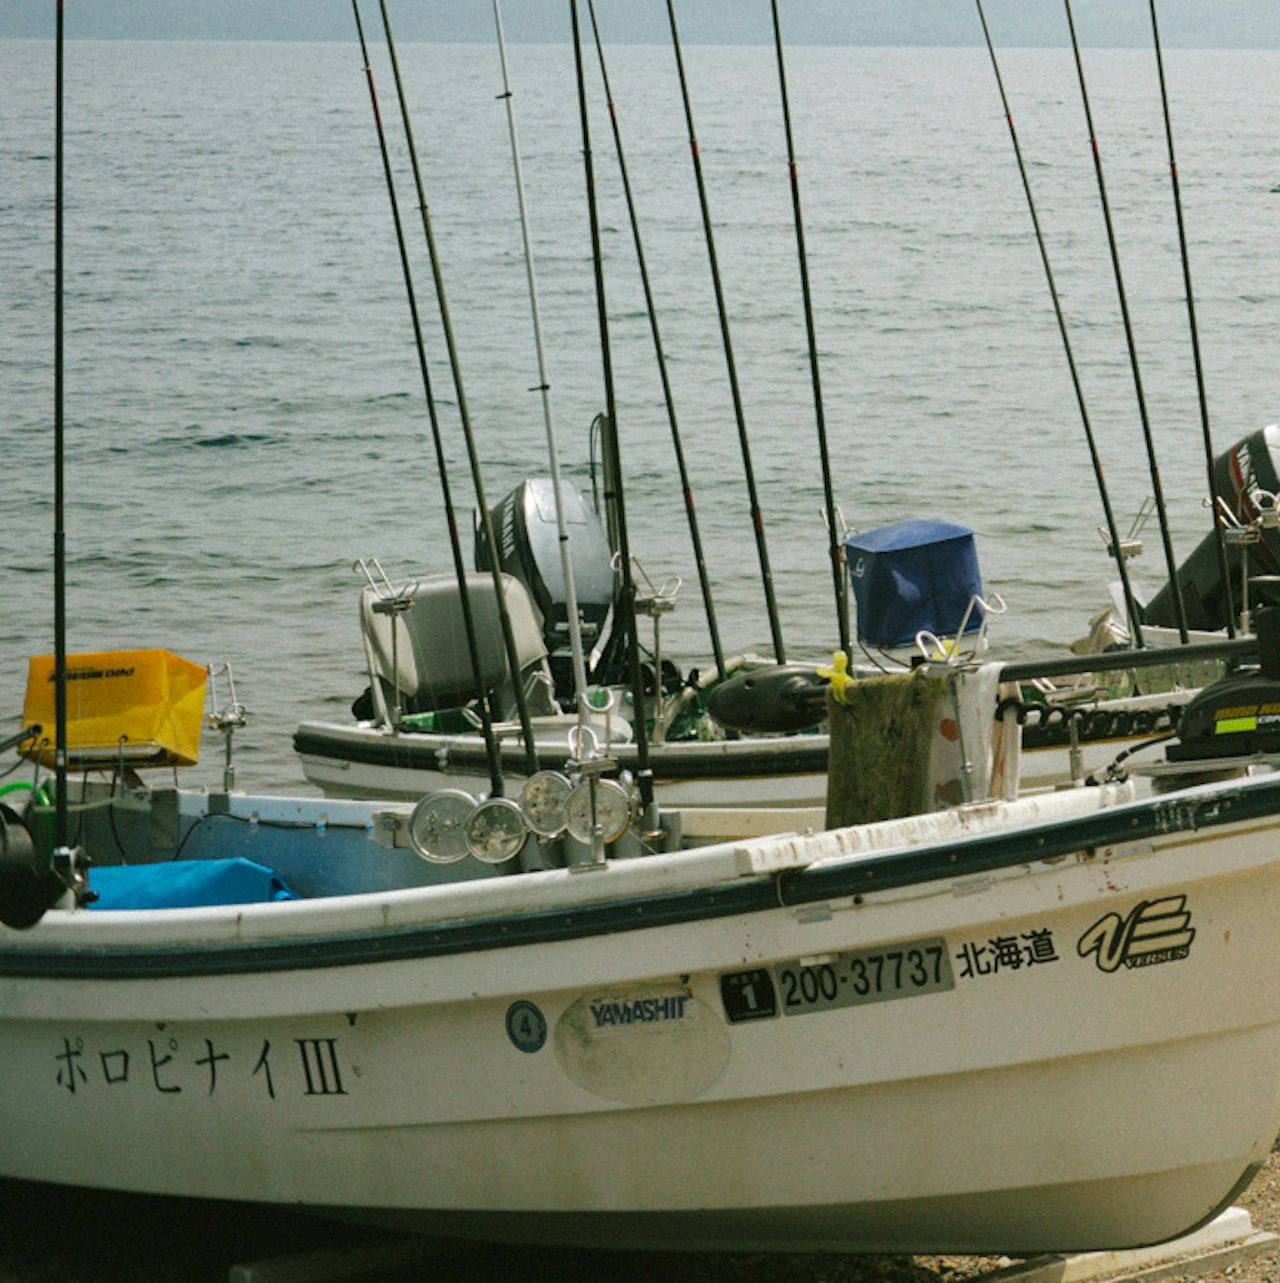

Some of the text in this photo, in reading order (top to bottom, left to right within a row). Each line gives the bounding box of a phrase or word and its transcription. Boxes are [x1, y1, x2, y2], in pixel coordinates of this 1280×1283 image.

[781, 945, 944, 1007] 200-37737
[956, 927, 1060, 979] 北海道
